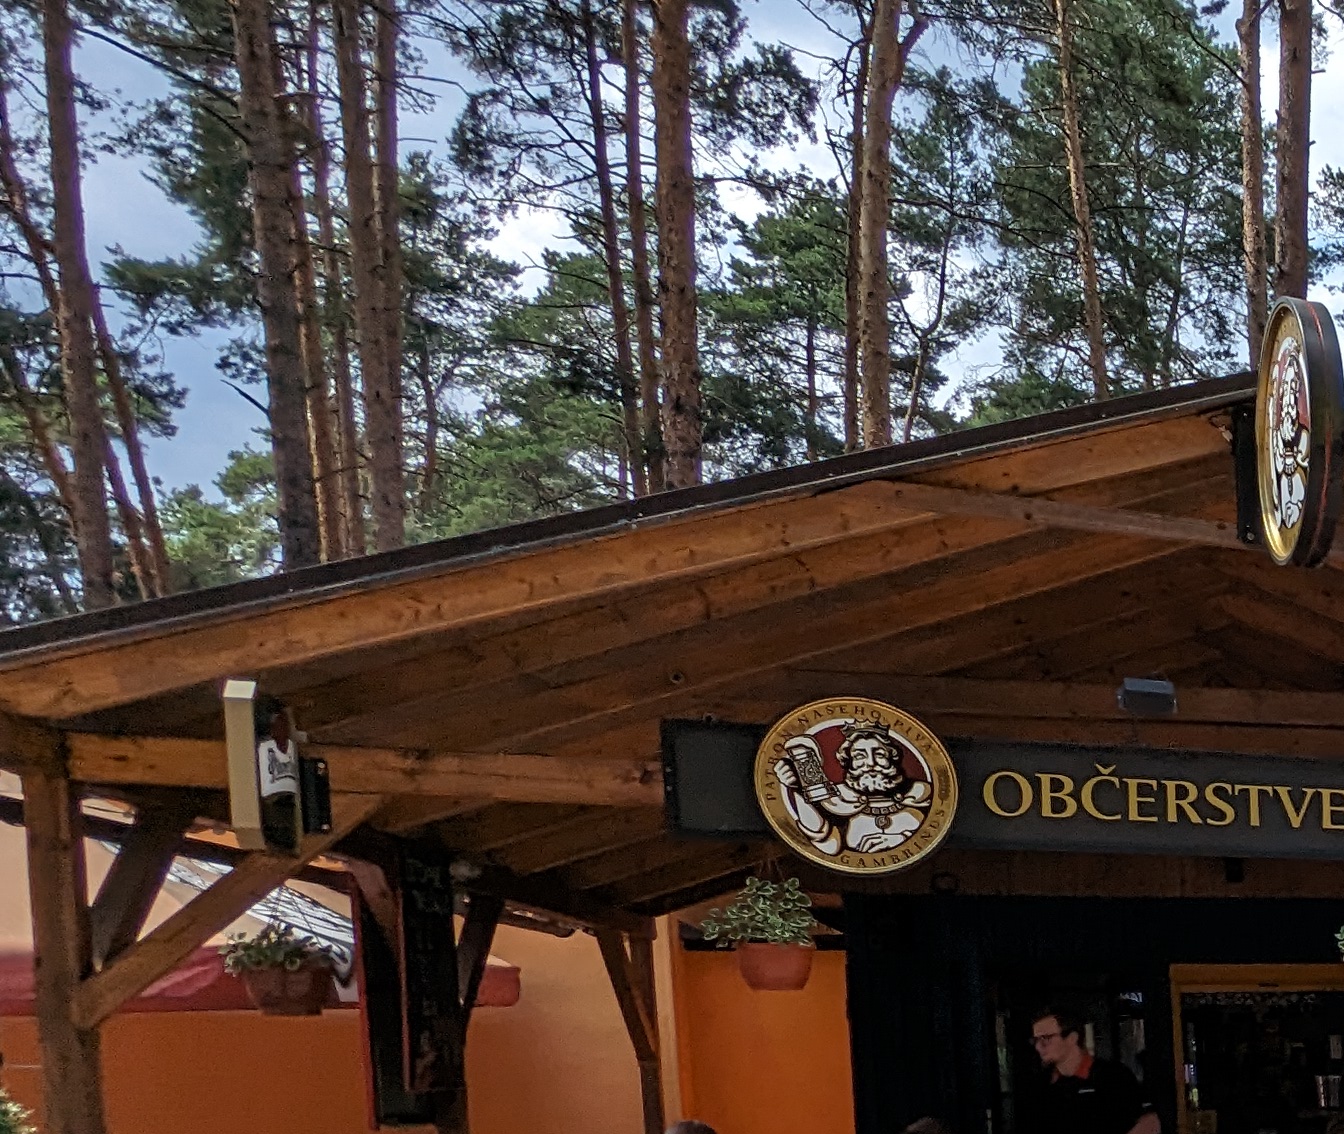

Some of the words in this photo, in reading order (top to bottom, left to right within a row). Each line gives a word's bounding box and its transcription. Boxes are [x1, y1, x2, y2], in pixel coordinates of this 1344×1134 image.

[766, 731, 794, 801] PATRON
[893, 720, 935, 752] PIVA
[840, 807, 946, 868] GAMBRINUS
